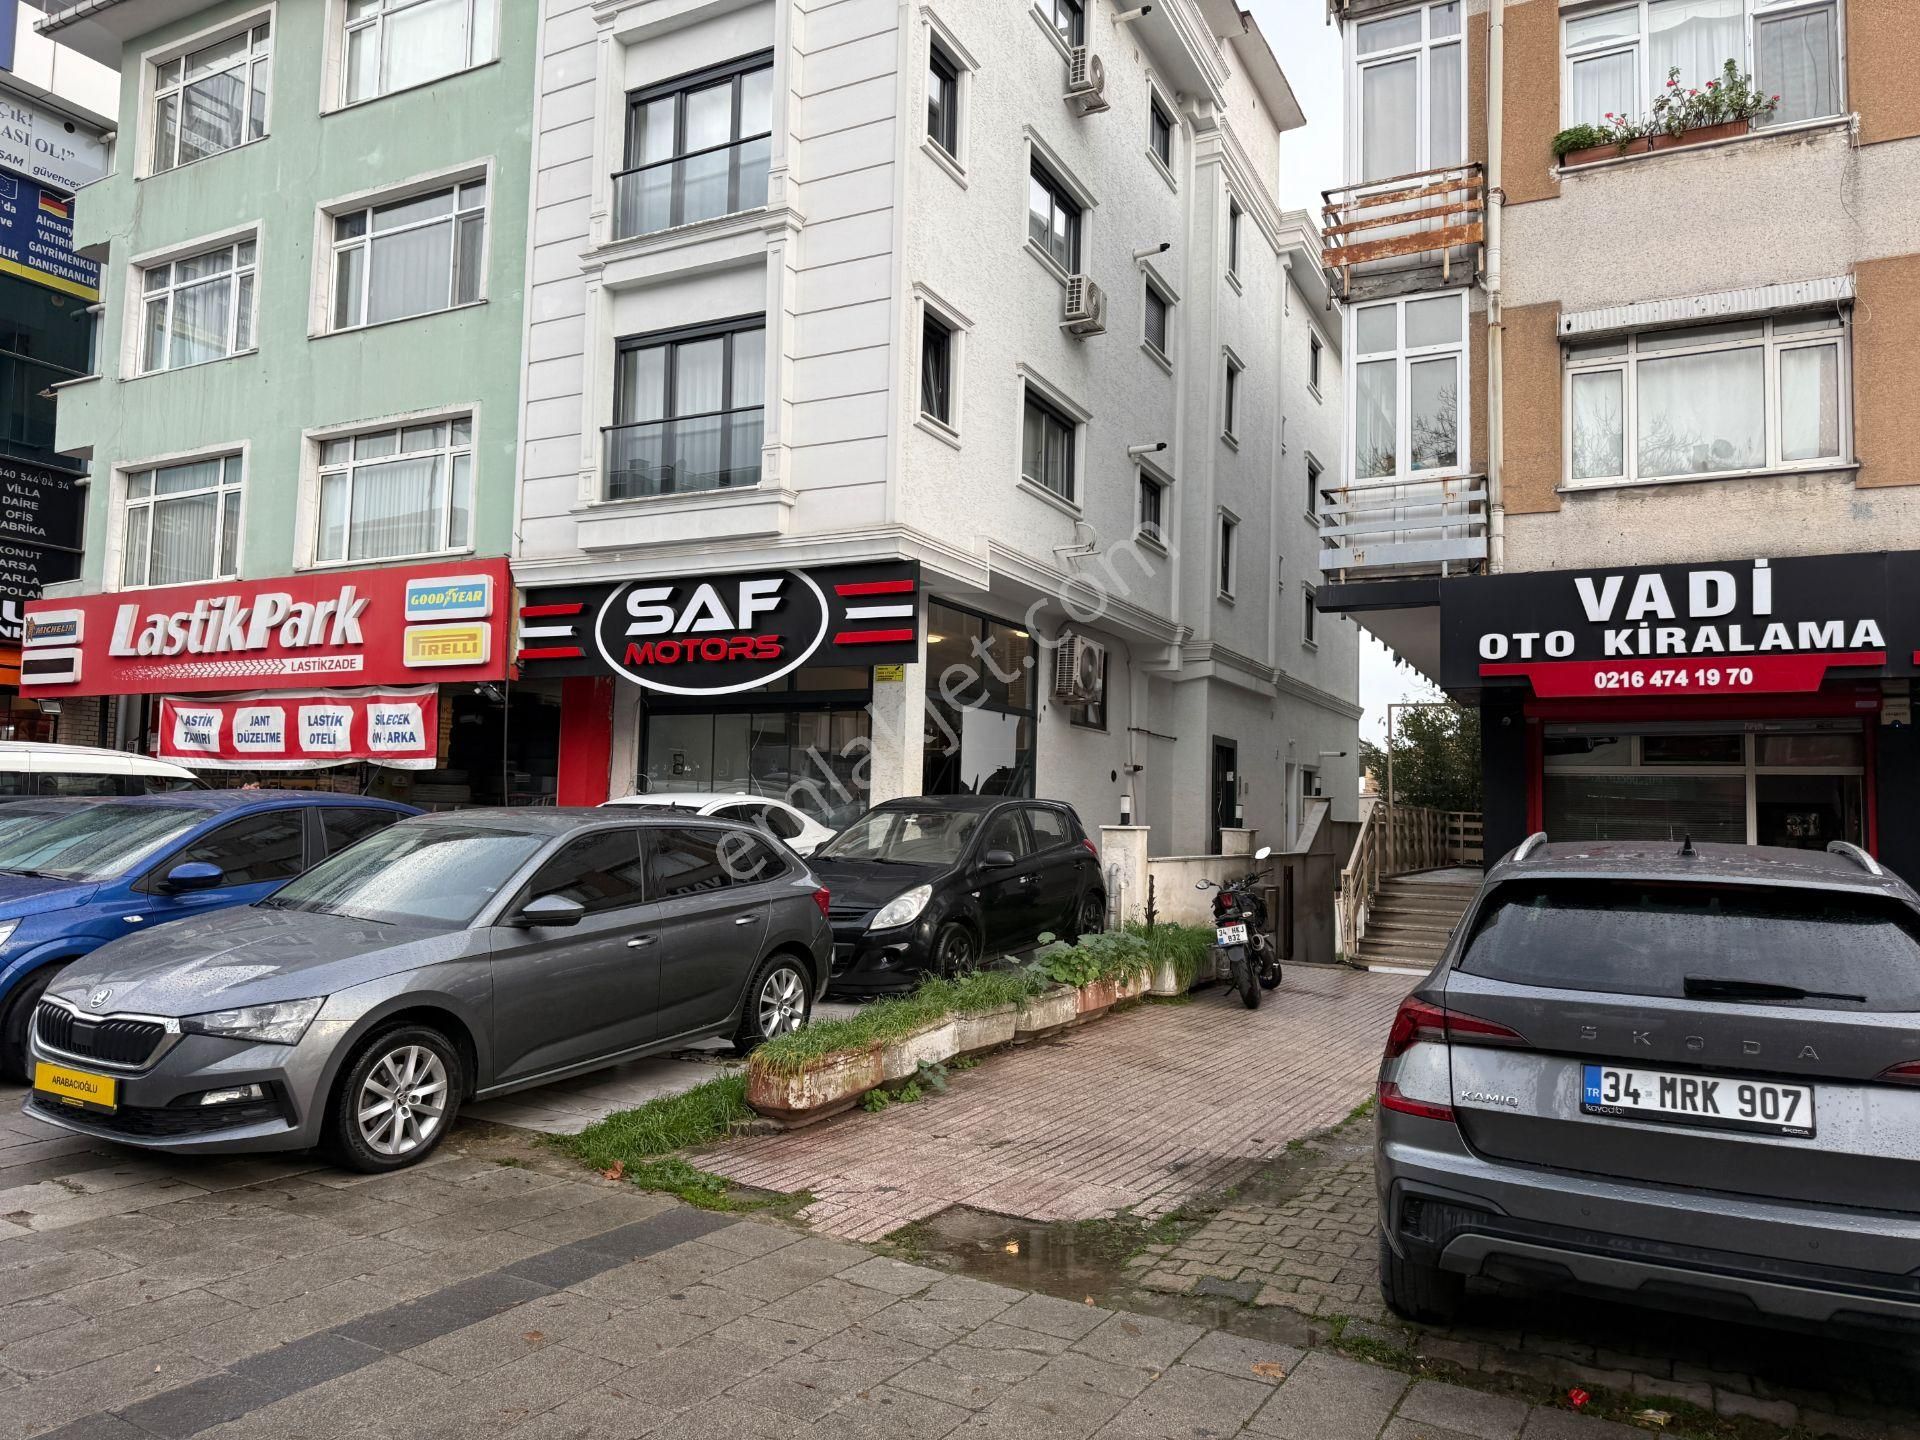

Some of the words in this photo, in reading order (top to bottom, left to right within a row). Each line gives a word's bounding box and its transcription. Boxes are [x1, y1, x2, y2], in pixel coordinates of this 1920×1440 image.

[28, 241, 98, 273] GAYRİMENKUL
[28, 255, 97, 287] DANIŞMANLIK
[6, 483, 41, 498] VİLLA
[2, 495, 39, 510] DAİRE
[5, 509, 33, 522] OFİS
[0, 519, 47, 537] ABRİKA
[0, 571, 40, 586] ARLA
[1574, 559, 1772, 622] VADİ
[625, 578, 784, 636] SAF
[35, 623, 75, 635] MICHELIN
[411, 633, 478, 656] PIRELLI
[1479, 630, 1575, 659] OTO
[1604, 619, 1887, 656] KİRALAMA
[623, 635, 785, 665] MOTORS
[291, 658, 356, 673] LASTİKZADE
[1594, 672, 1644, 689] 0216
[1649, 670, 1689, 687] 474
[1695, 669, 1721, 686] 19
[1726, 667, 1753, 685] 70
[249, 715, 271, 727] JANT
[307, 714, 343, 727] LASTİK
[236, 730, 281, 744] DÜZELTME
[309, 730, 336, 745] OTELİ
[387, 731, 417, 744] ARKA
[1461, 1090, 1520, 1108] KAMIQ
[1586, 1088, 1600, 1098] TR
[1603, 1071, 1641, 1106] 34
[1659, 1076, 1720, 1114] MRK
[1737, 1084, 1801, 1122] 907
